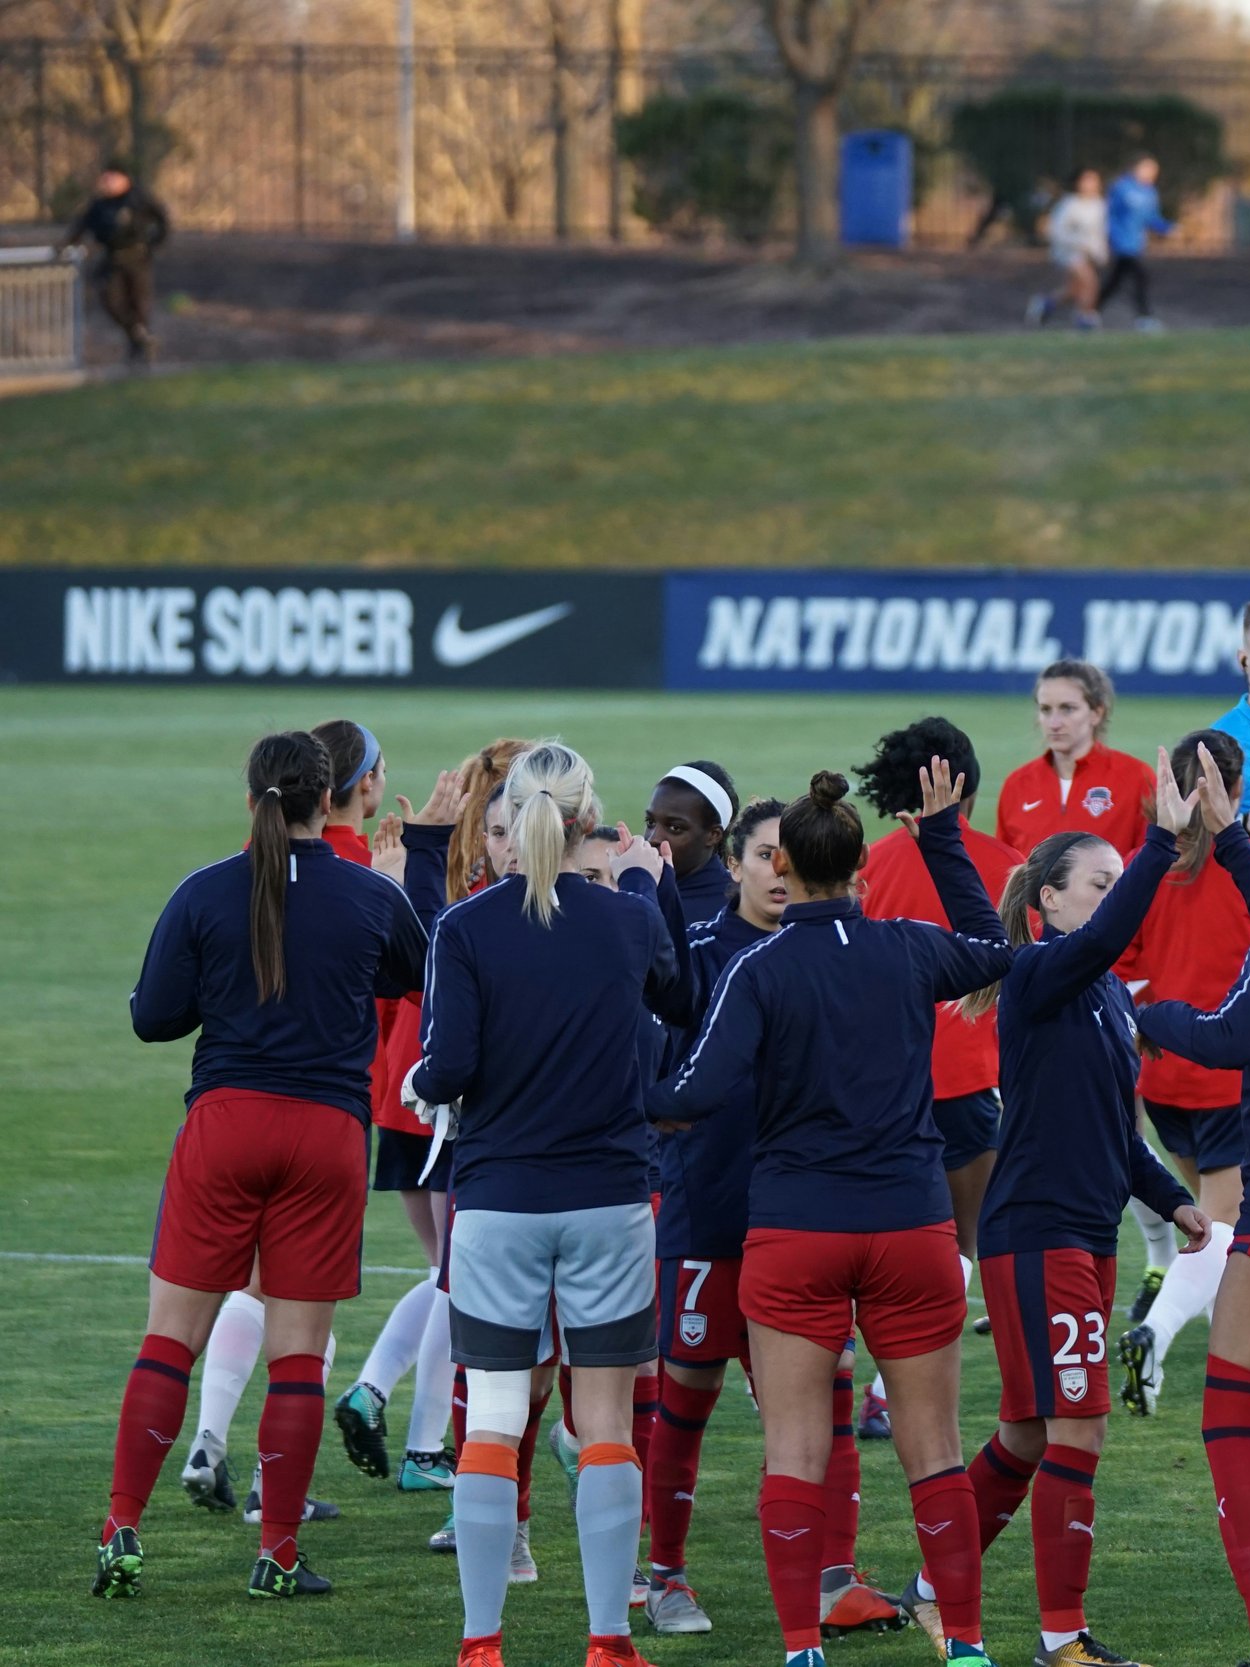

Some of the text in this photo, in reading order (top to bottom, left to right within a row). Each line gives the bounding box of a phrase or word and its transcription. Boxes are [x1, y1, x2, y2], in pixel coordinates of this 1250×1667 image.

[66, 588, 412, 674] NIKE SOCCER
[701, 598, 1061, 670] NATIONAL
[682, 1260, 711, 1310] 7
[1052, 1312, 1105, 1364] 23
